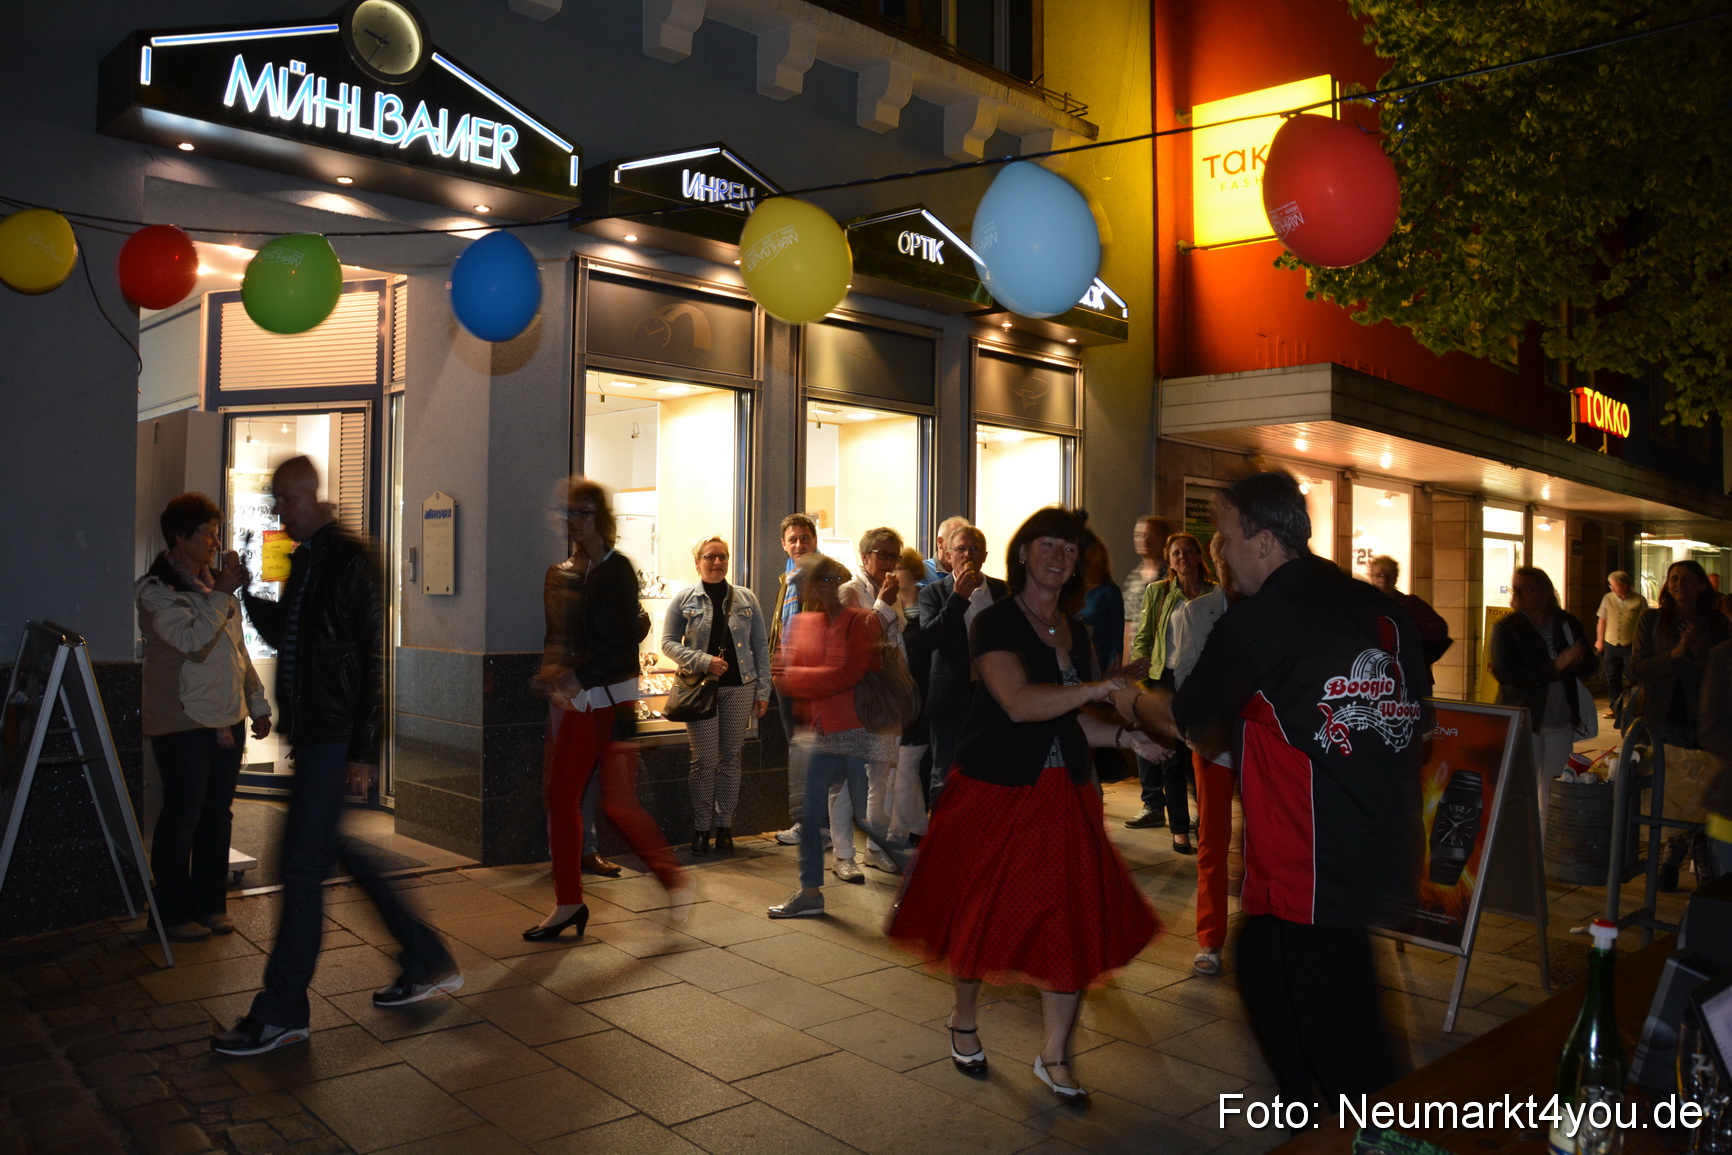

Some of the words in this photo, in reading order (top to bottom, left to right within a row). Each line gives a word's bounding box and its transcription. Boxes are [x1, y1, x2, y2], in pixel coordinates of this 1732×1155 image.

[223, 53, 521, 175] MÜHLBAUER
[682, 168, 756, 214] UHREN
[897, 230, 945, 266] OPTIK
[1324, 677, 1395, 700] Boogie
[1433, 726, 1459, 737] ENA
